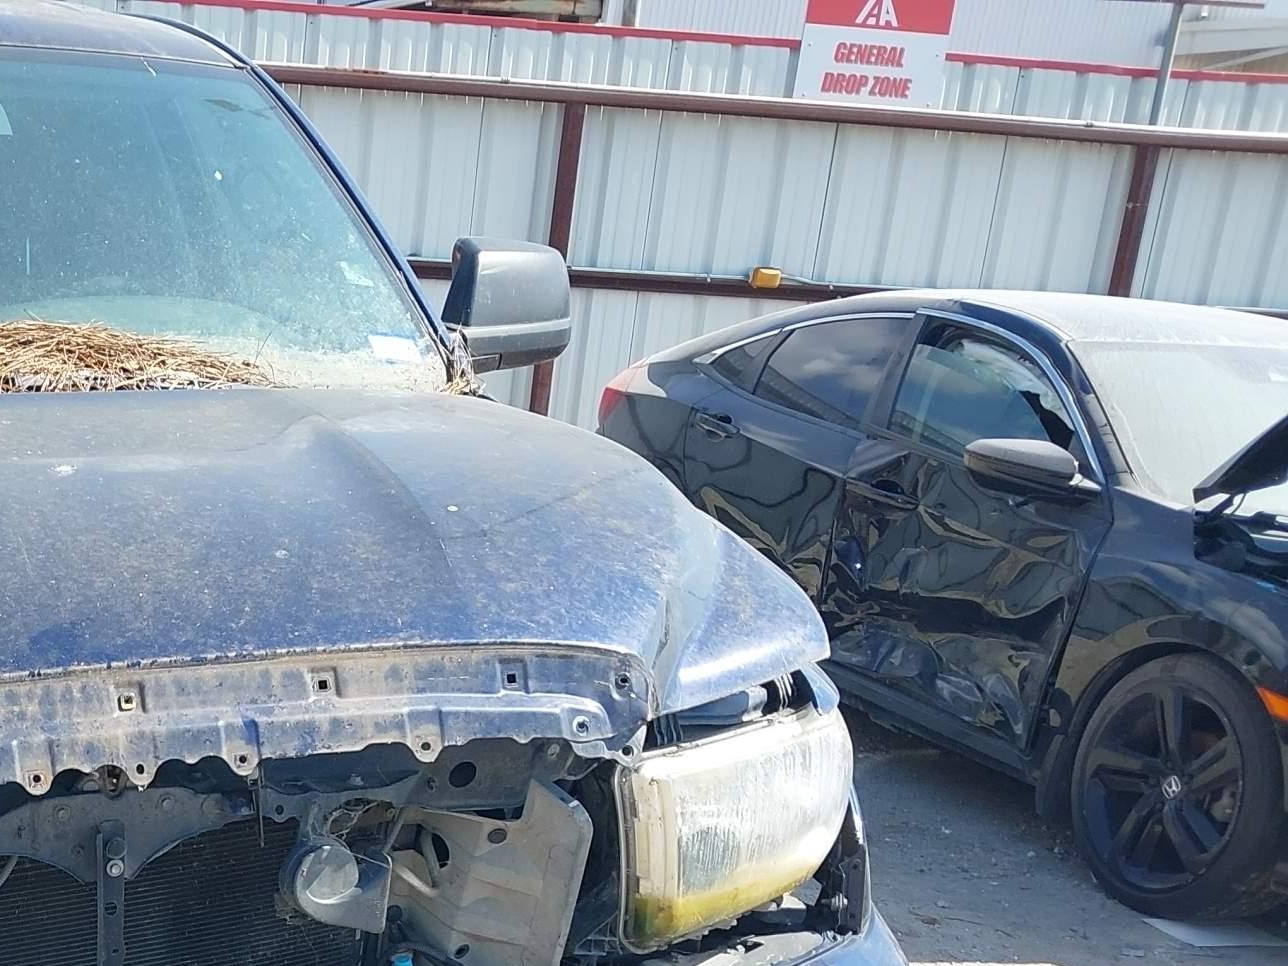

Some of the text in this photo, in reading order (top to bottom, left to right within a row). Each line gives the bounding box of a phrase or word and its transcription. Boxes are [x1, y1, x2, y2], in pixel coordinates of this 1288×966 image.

[834, 42, 906, 68] GENERAL
[820, 72, 913, 99] DROP ZONE
